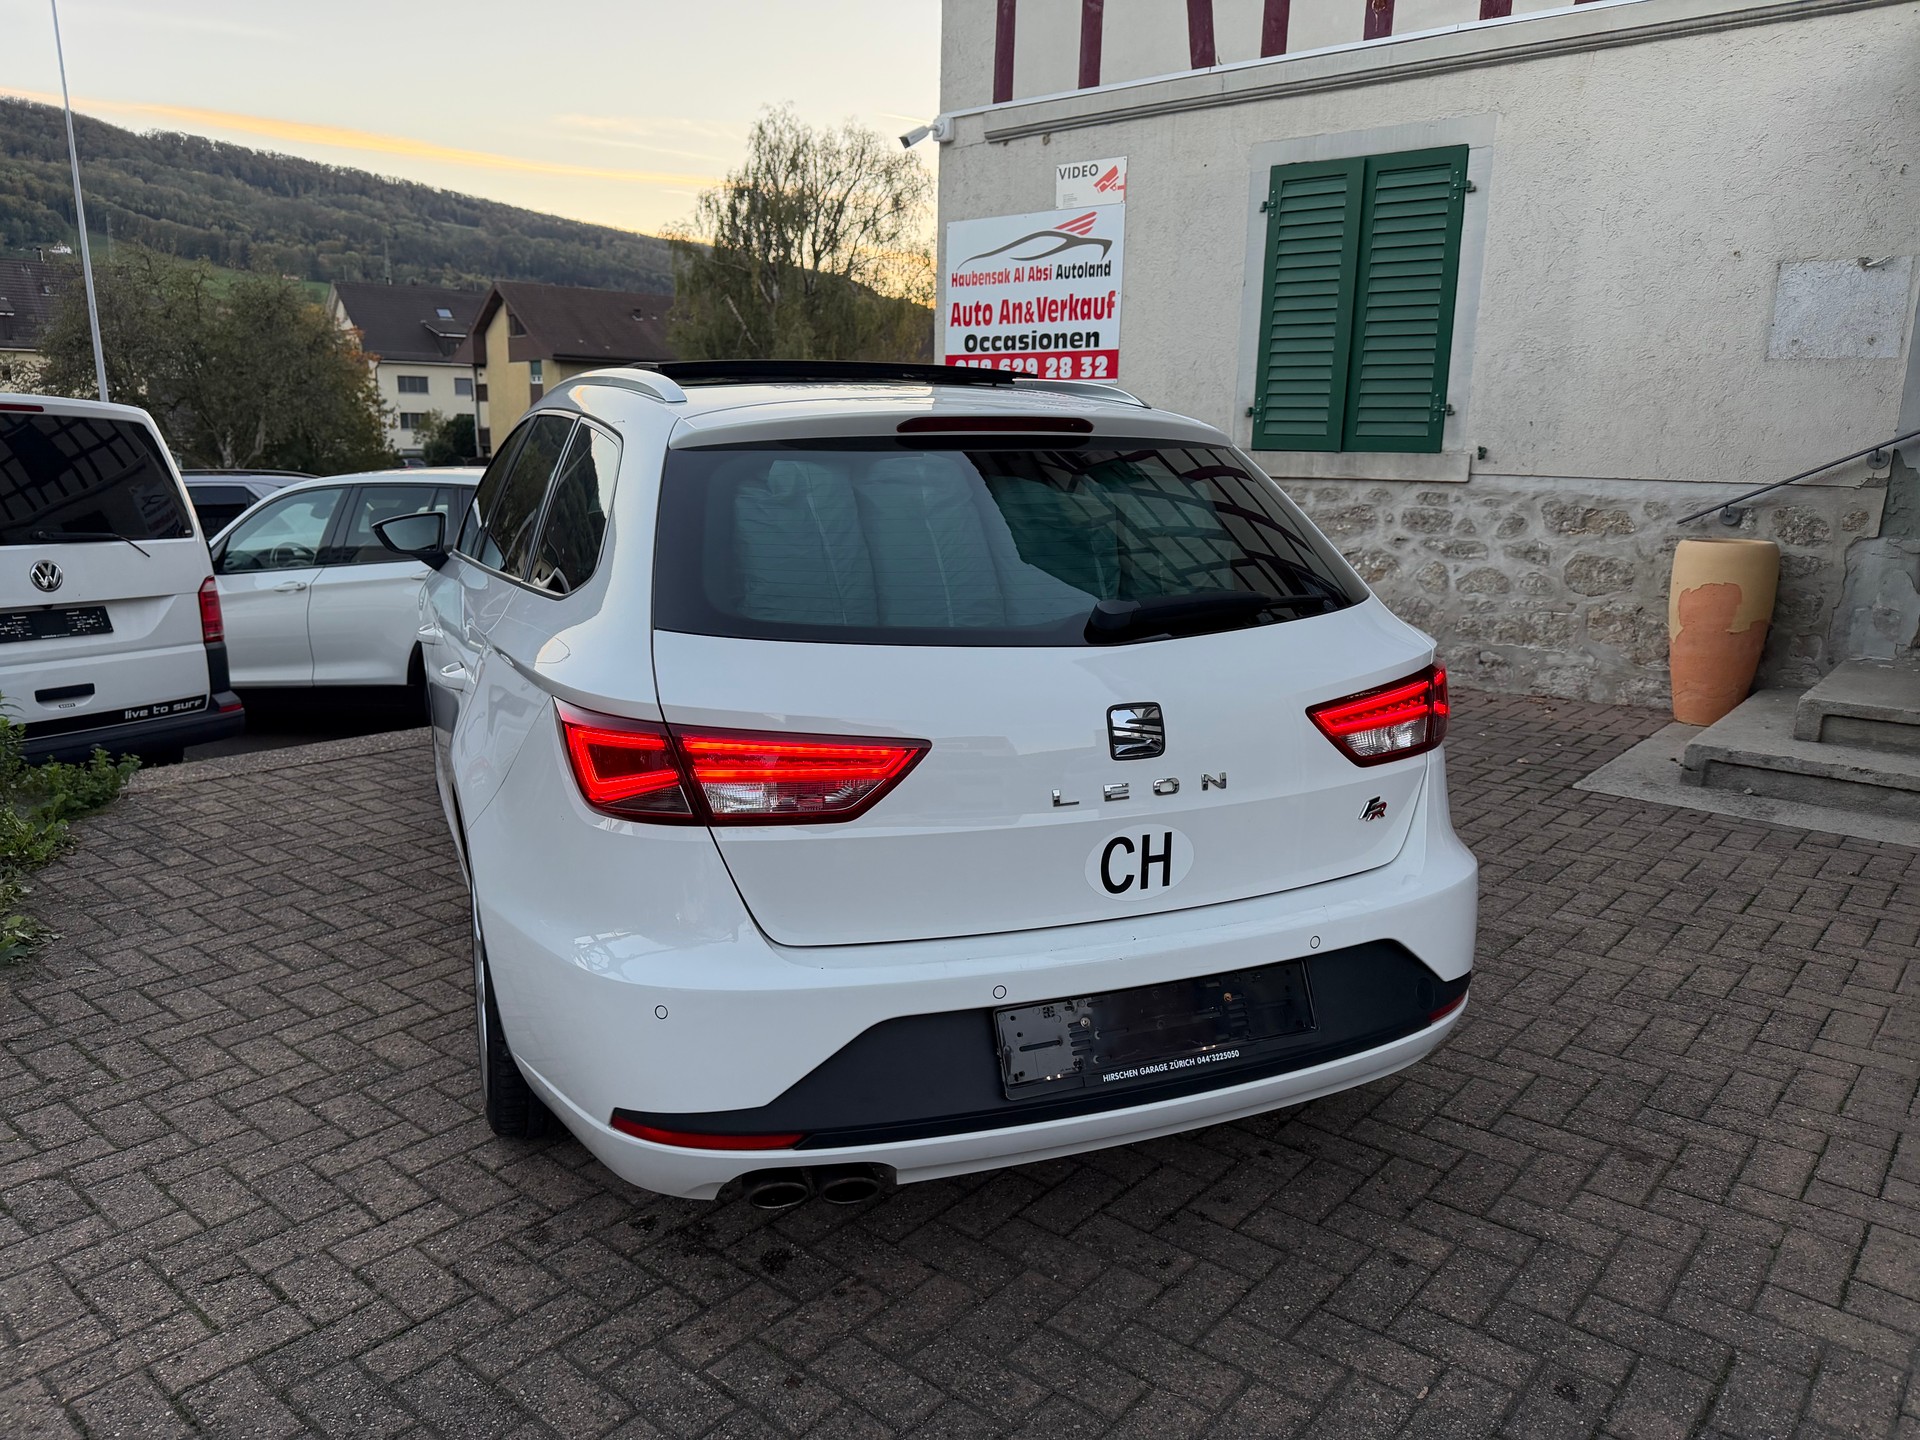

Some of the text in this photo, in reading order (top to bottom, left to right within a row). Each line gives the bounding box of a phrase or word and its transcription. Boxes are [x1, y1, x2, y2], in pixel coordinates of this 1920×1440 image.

[1058, 163, 1099, 180] VIDEO
[951, 260, 1112, 288] Haubensak Al Absi Autoland
[950, 290, 1116, 327] Auto An&Verkauf
[964, 330, 1100, 353] Occasionen
[1045, 356, 1073, 378] 28
[1080, 355, 1108, 378] 32
[31, 560, 62, 590] VW
[125, 699, 203, 719] live to surf
[1051, 771, 1227, 807] LEON
[1100, 831, 1172, 894] CH
[1102, 1069, 1138, 1082] HIRSCHEN
[1139, 1063, 1168, 1076] GARAGE
[1169, 1058, 1195, 1070] ZÜRICH
